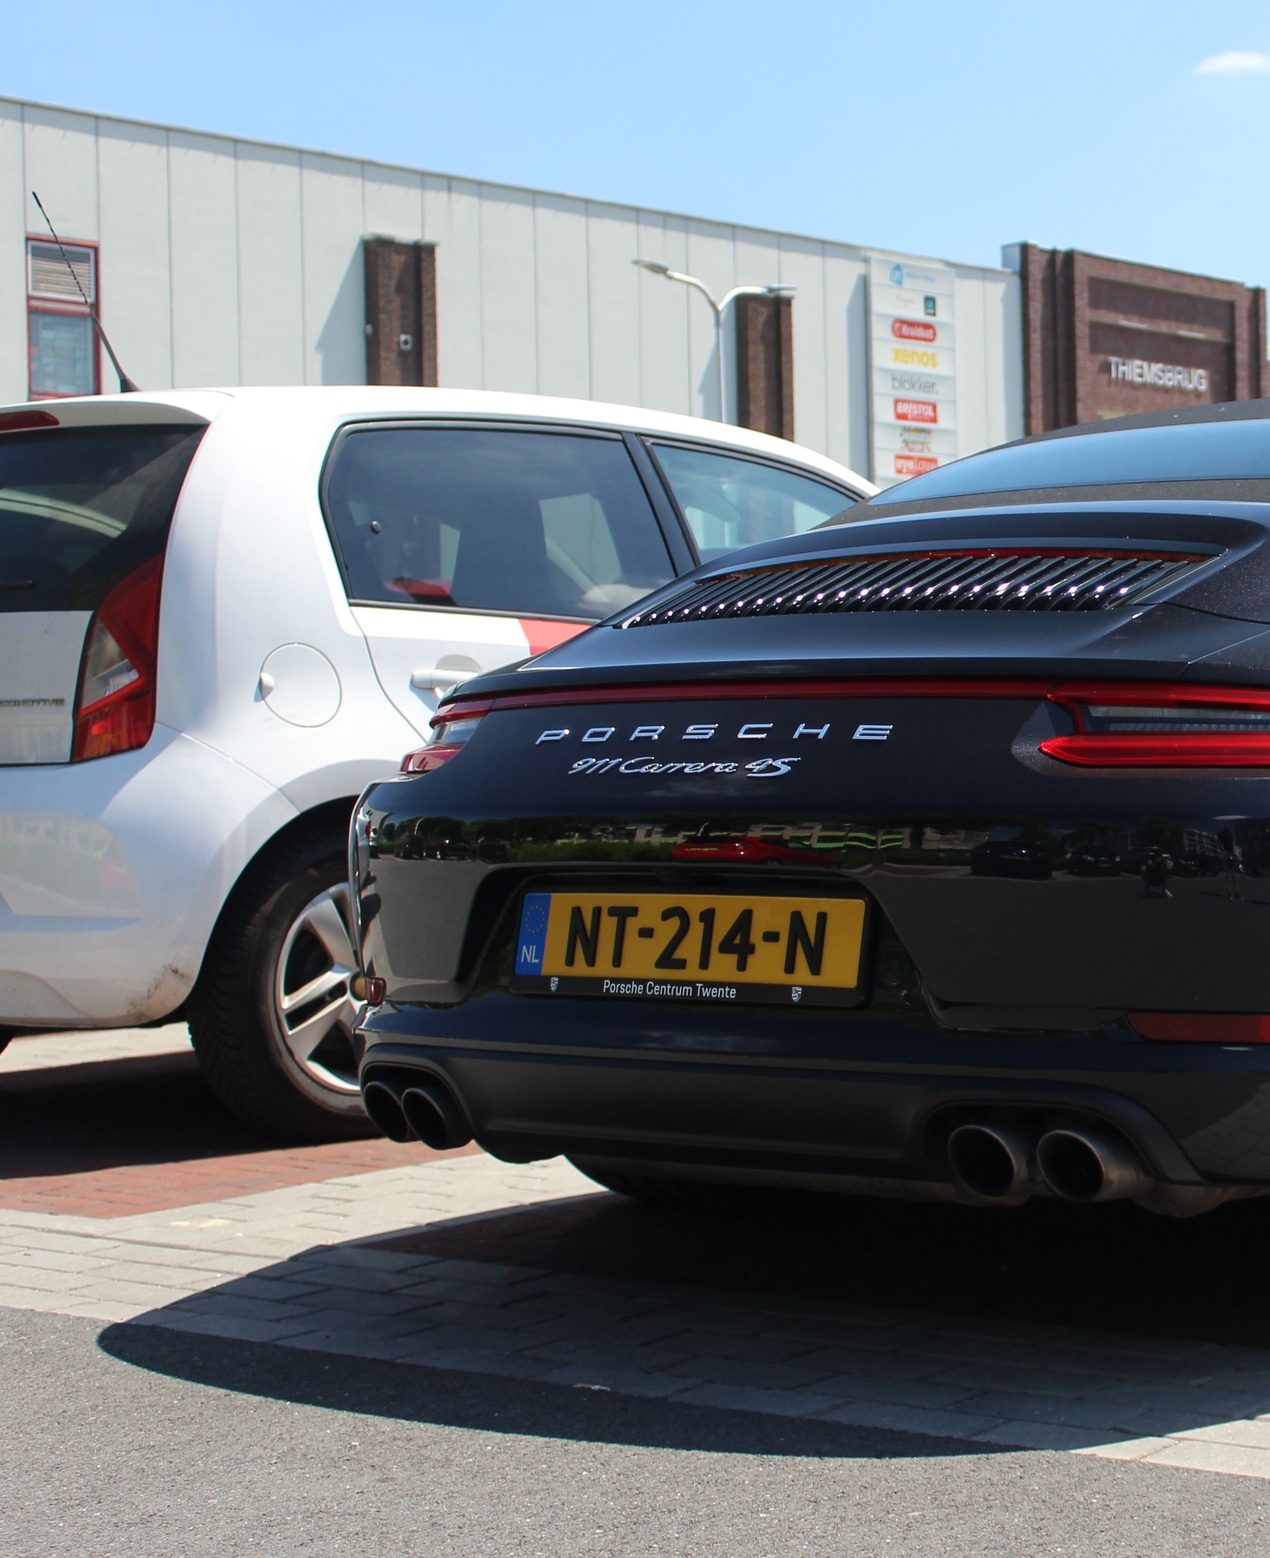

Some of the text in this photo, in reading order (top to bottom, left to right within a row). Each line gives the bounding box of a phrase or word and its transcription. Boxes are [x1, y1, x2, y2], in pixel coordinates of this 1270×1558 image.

[892, 347, 938, 368] xenos
[1109, 357, 1208, 393] THIEMSBRUG
[896, 401, 935, 418] BRISTOL
[535, 723, 893, 745] PORSCHE
[568, 756, 801, 777] 911 Carrera 4S
[564, 905, 828, 976] NT-214-N
[521, 945, 540, 963] NL
[603, 979, 737, 999] Porsche Centrum Twente
